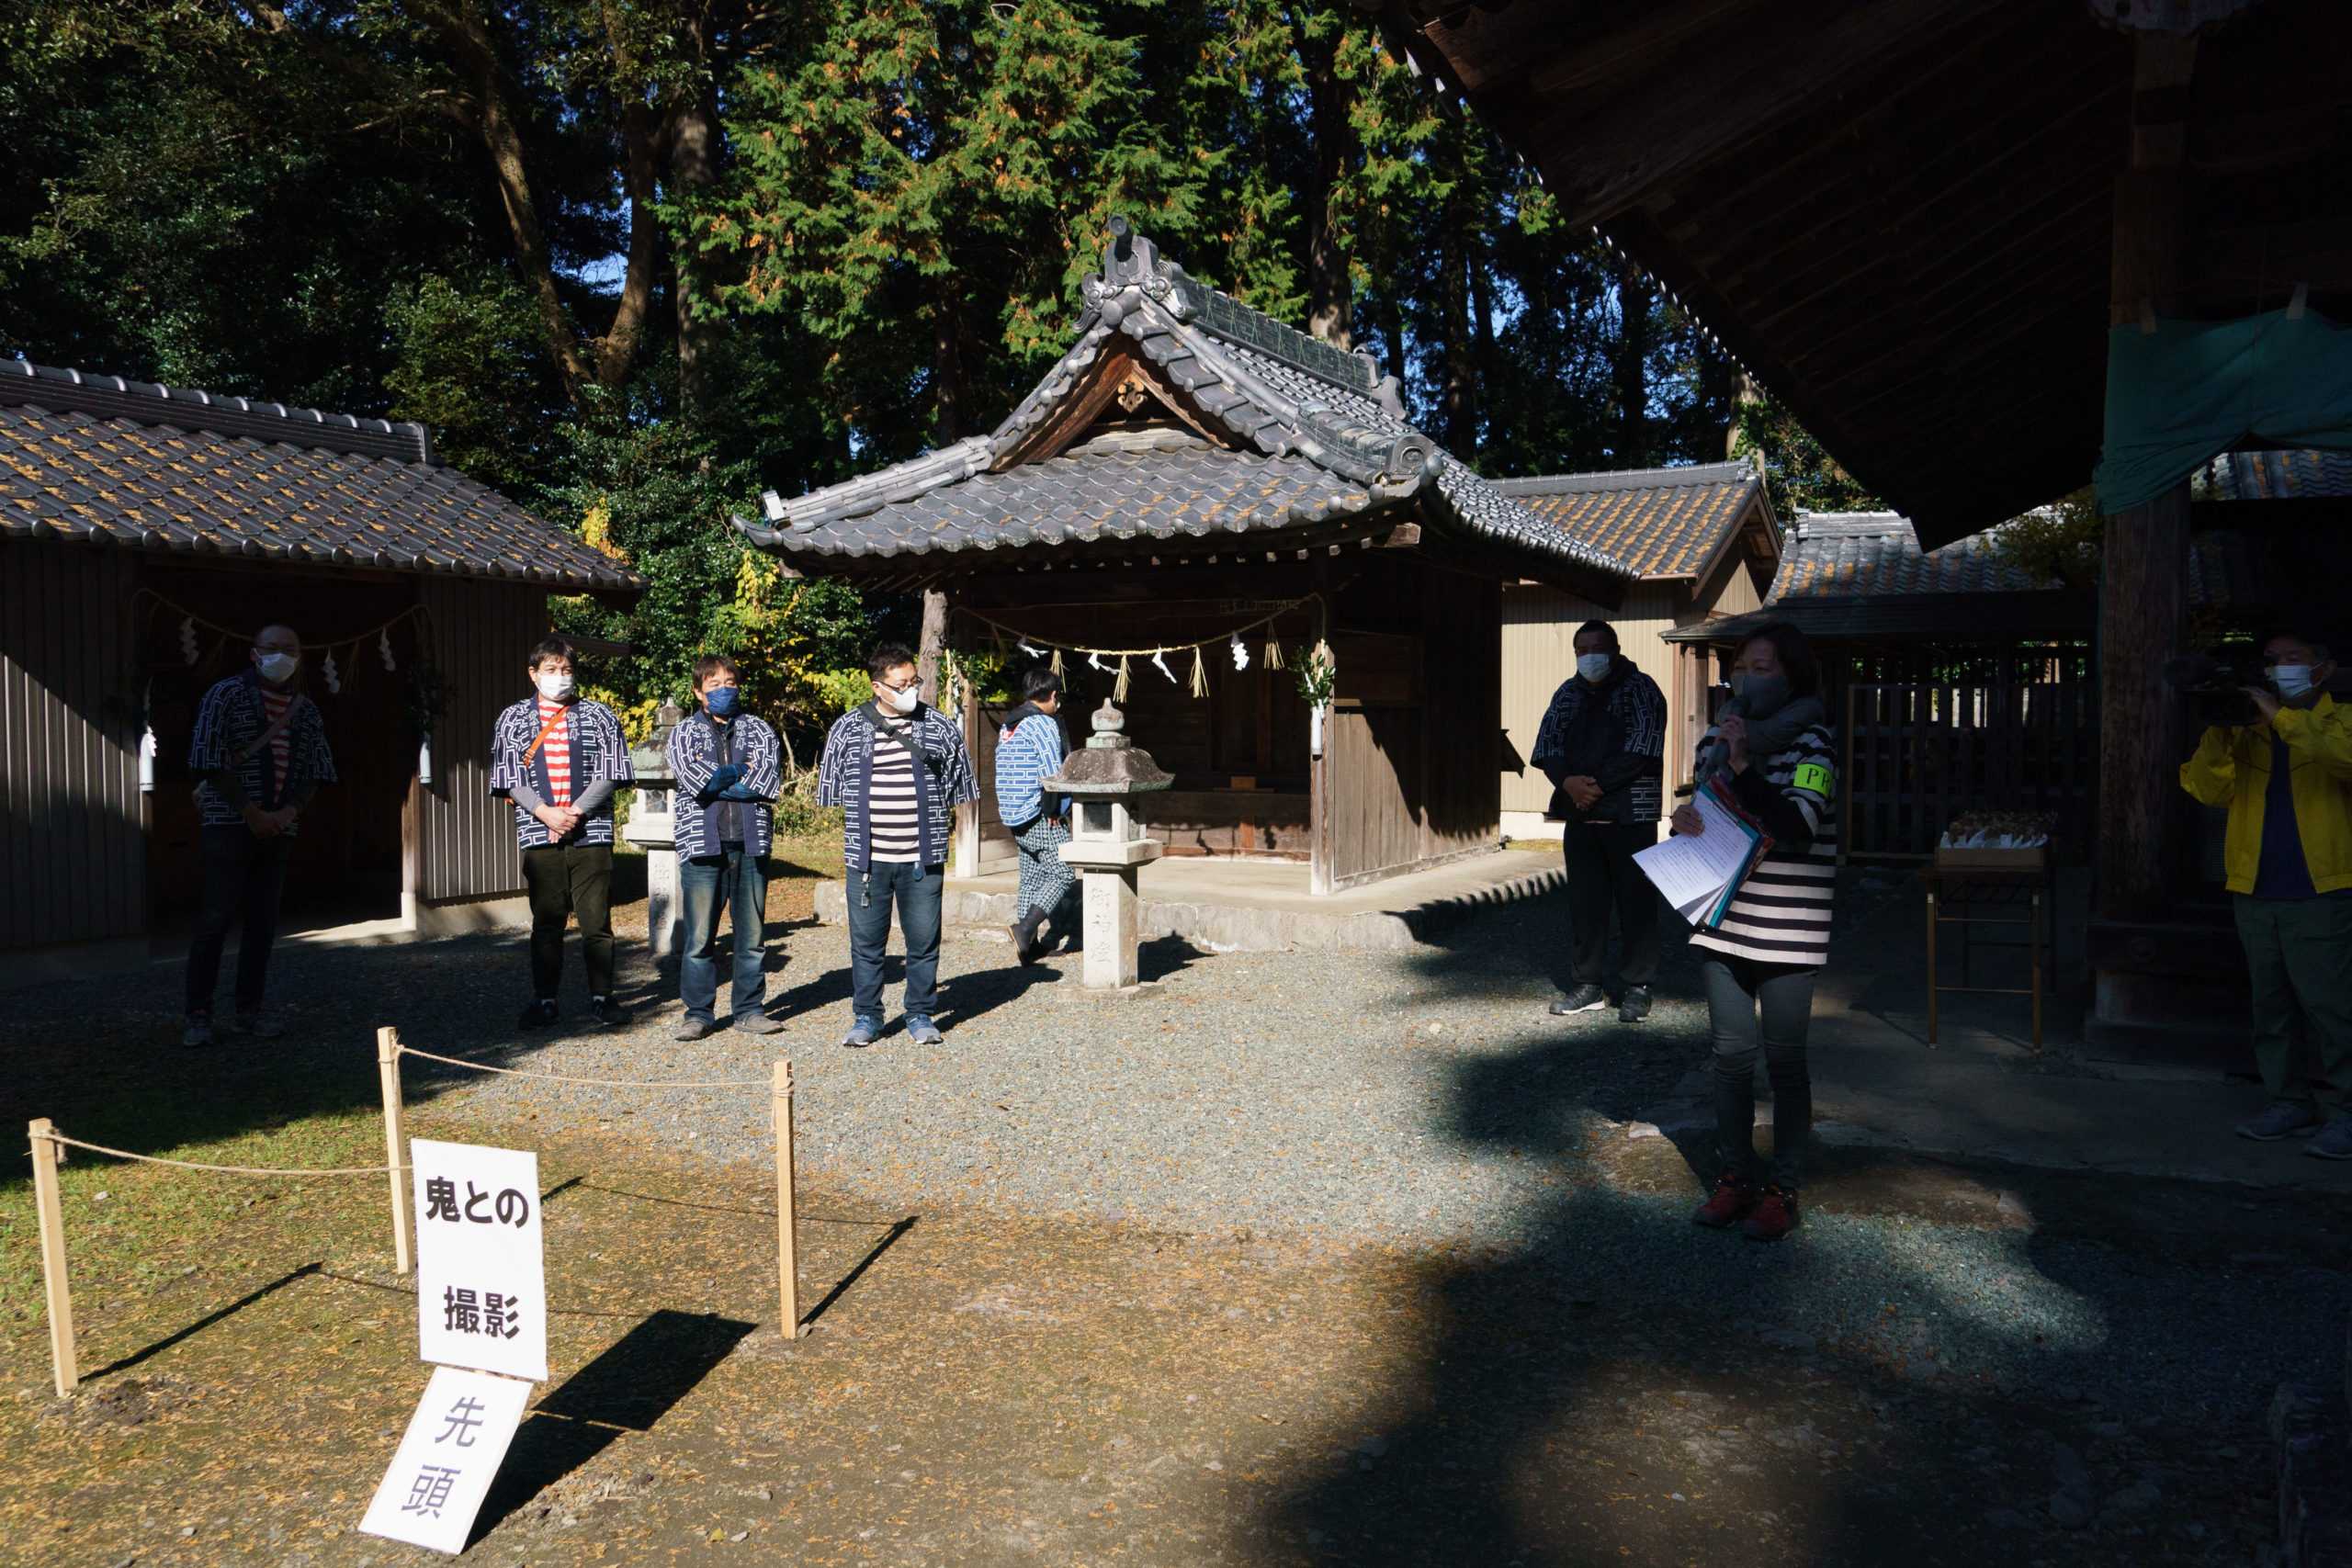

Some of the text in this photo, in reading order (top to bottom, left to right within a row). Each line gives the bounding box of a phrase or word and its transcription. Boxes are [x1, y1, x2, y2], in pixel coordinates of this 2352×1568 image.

[426, 1177, 528, 1228] 鬼との
[444, 1286, 519, 1338] 撮影
[401, 1397, 484, 1518] 先頭
